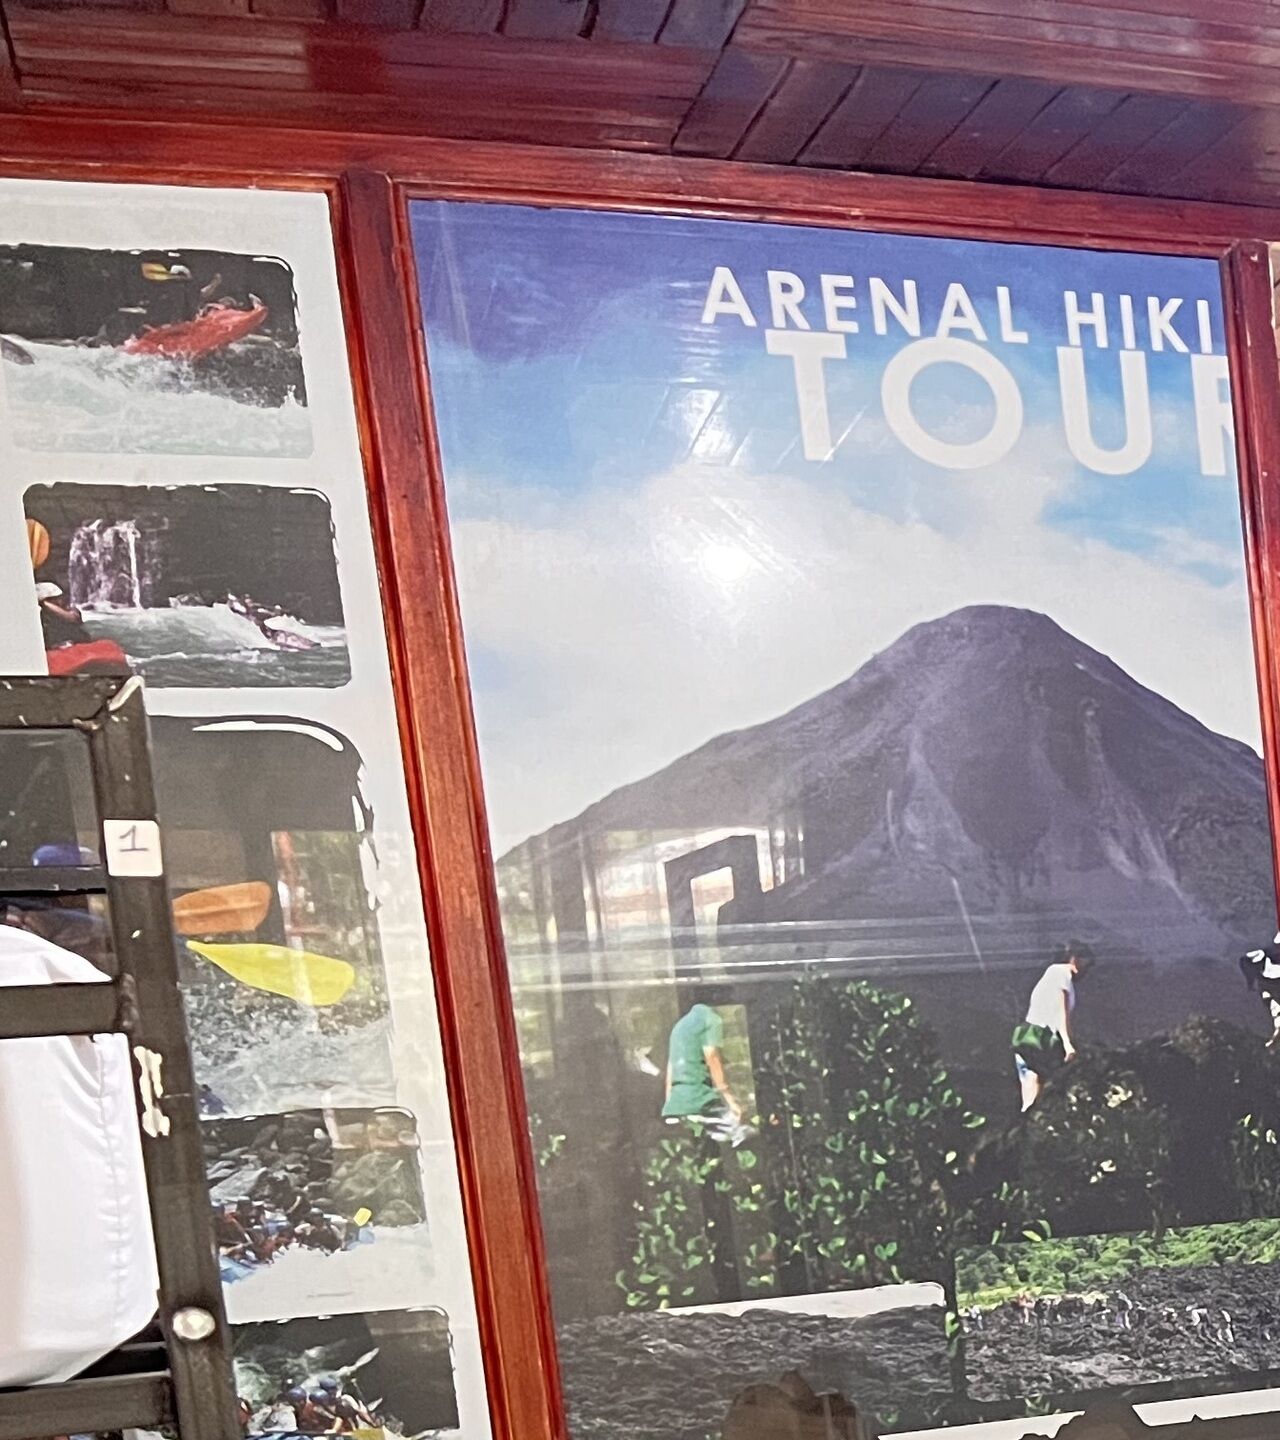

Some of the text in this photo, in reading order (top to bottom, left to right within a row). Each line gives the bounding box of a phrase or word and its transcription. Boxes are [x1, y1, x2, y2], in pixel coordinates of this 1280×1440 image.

[701, 266, 1213, 354] ARENAL HIKI
[118, 825, 148, 853] 1
